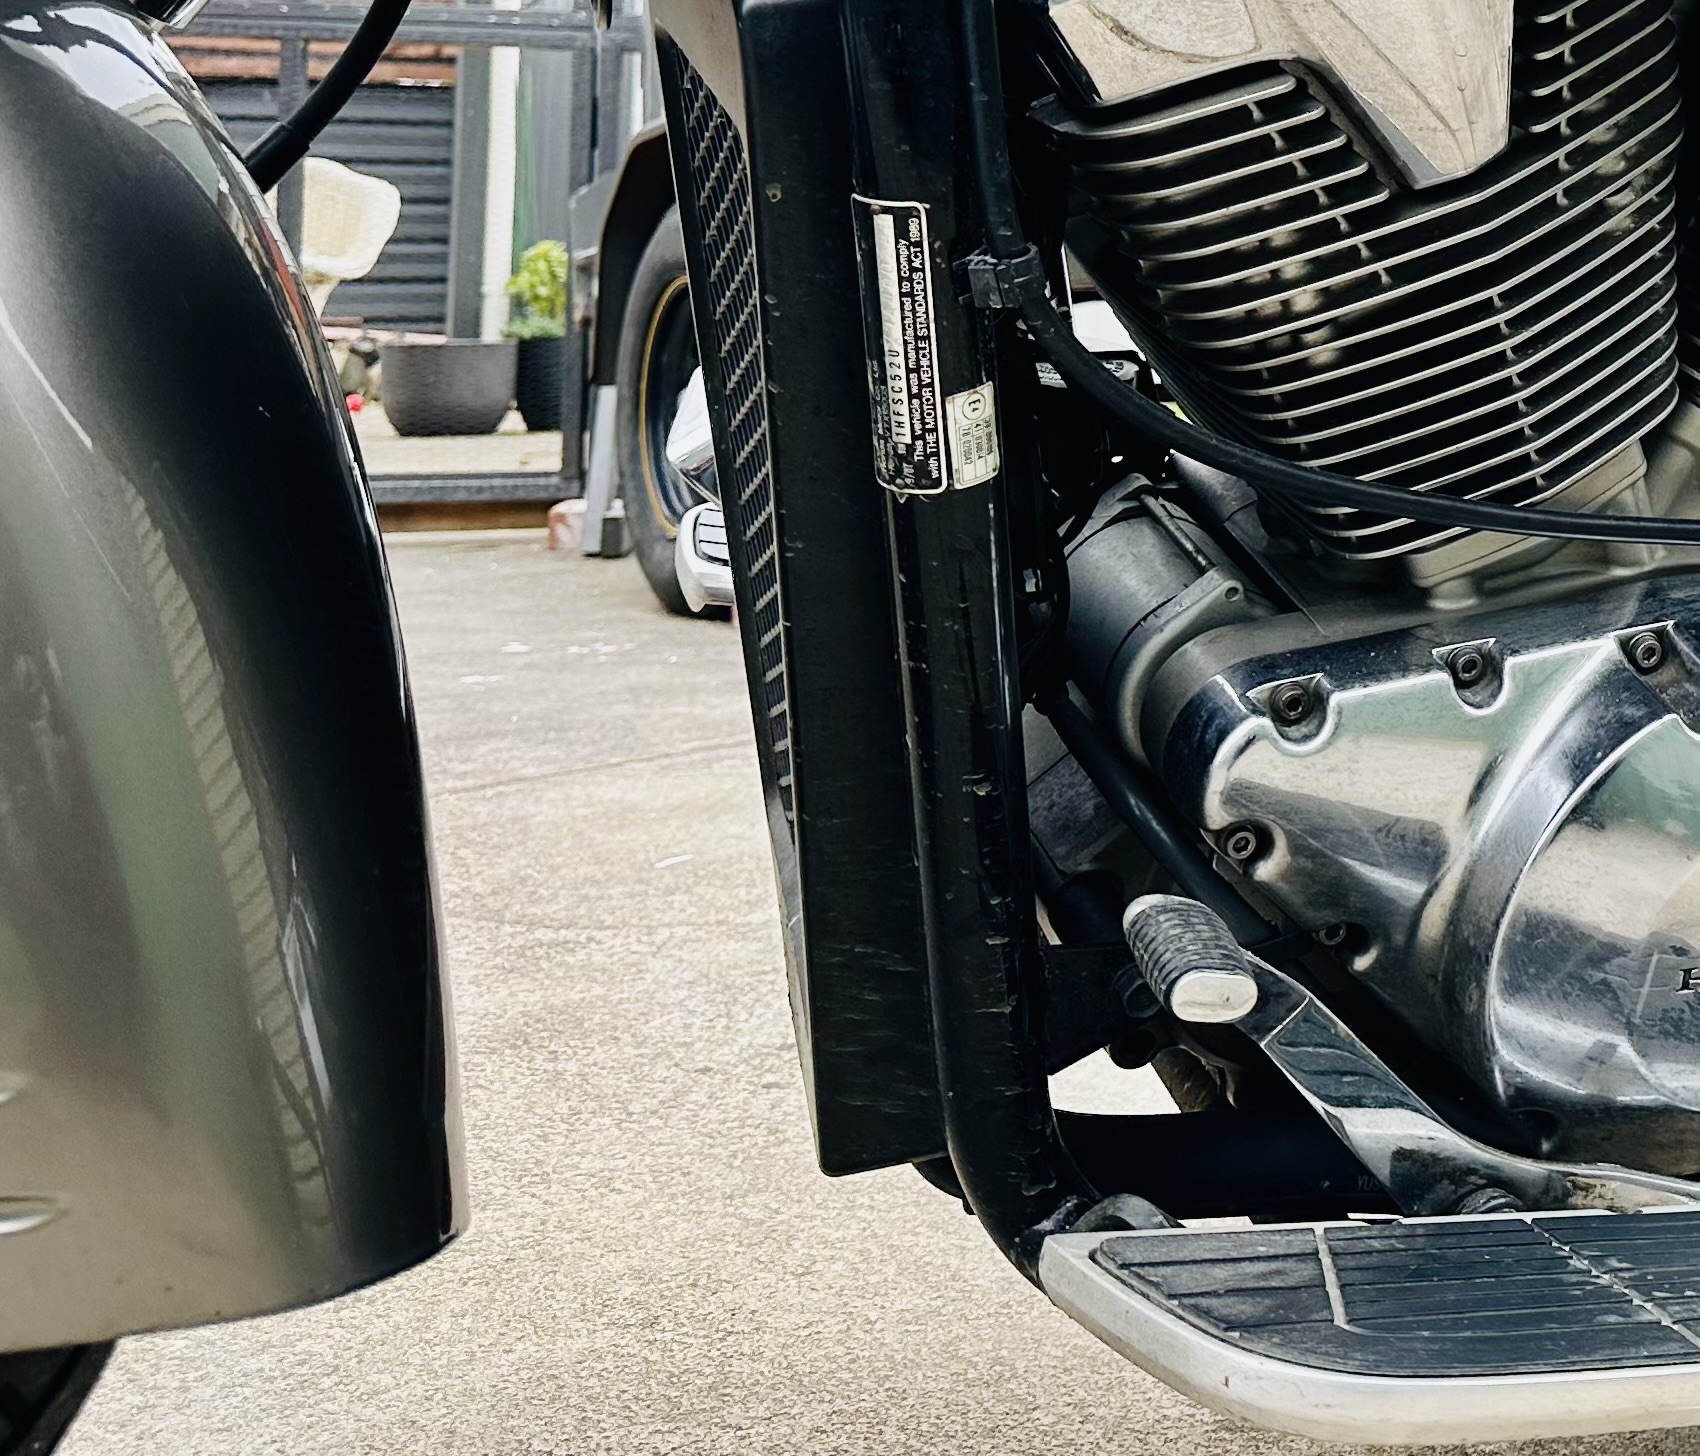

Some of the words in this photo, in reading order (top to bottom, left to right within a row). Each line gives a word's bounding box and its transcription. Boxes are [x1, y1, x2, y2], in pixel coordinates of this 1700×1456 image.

[908, 219, 920, 242] 1989
[897, 240, 910, 277] comply
[911, 247, 922, 269] ACT
[902, 283, 910, 292] to
[913, 273, 927, 336] STANDARDS
[902, 298, 916, 369] manufactured
[918, 341, 931, 384] VEHICLE
[889, 351, 905, 437] 1HFSC52U
[910, 374, 919, 394] was
[910, 400, 922, 435] vehicle
[923, 389, 935, 428] MOTOR
[913, 441, 924, 461] This
[926, 433, 937, 453] THE
[928, 458, 939, 478] with
